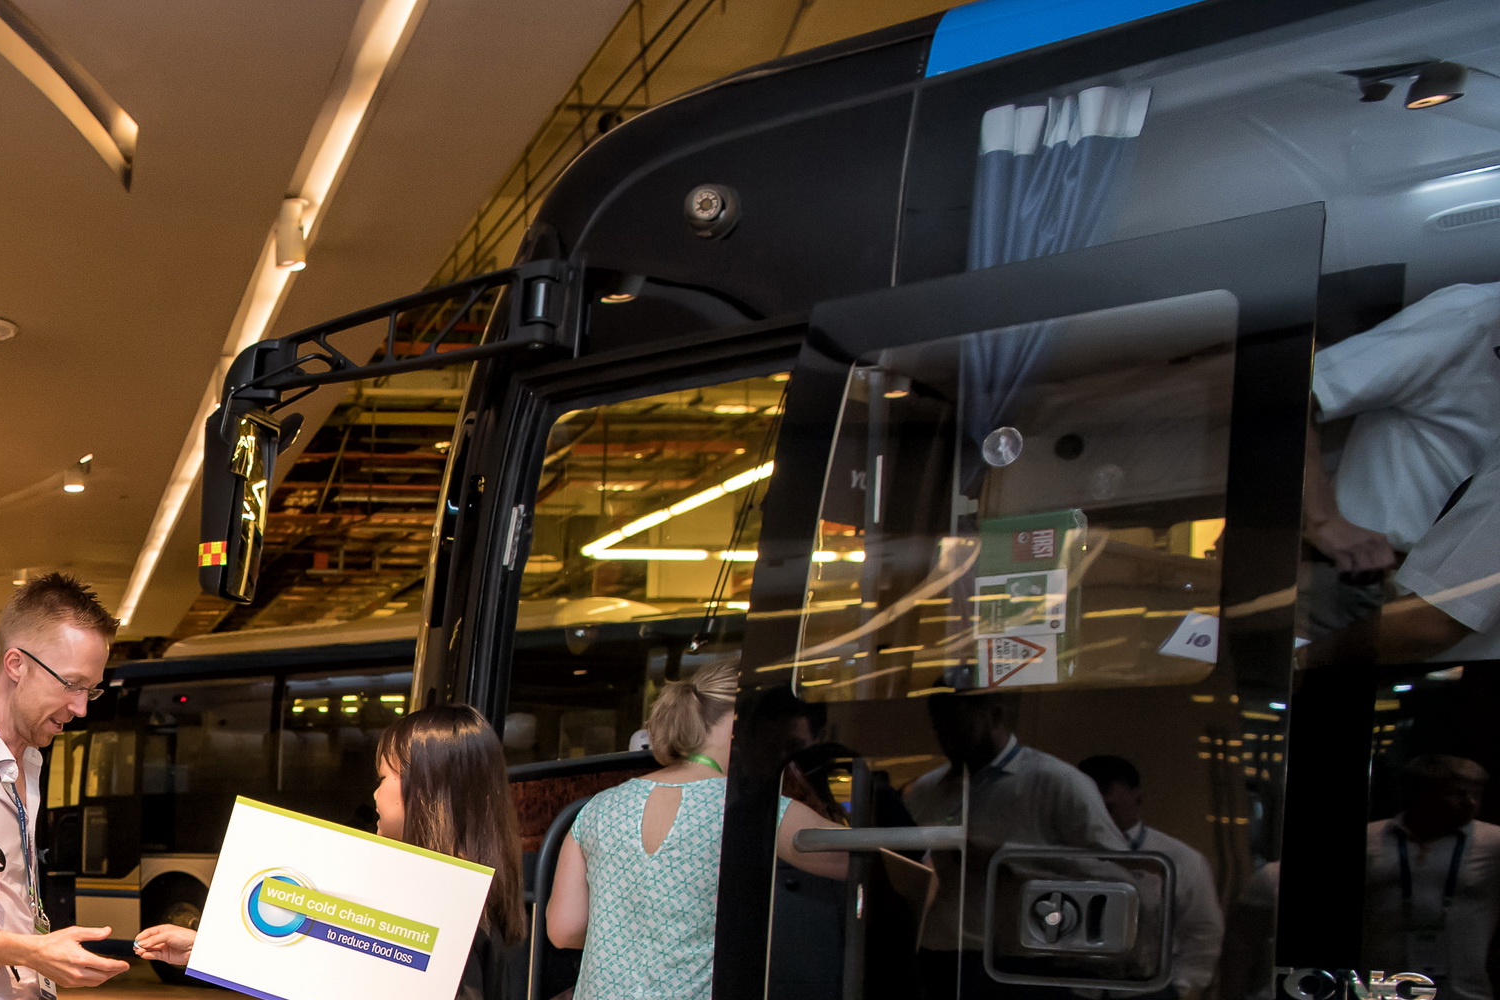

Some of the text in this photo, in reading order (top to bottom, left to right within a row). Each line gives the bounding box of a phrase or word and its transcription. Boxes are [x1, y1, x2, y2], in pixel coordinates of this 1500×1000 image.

[1032, 528, 1055, 559] FIRST
[266, 887, 431, 945] world cold chain summit
[326, 928, 414, 964] to reduce food loss
